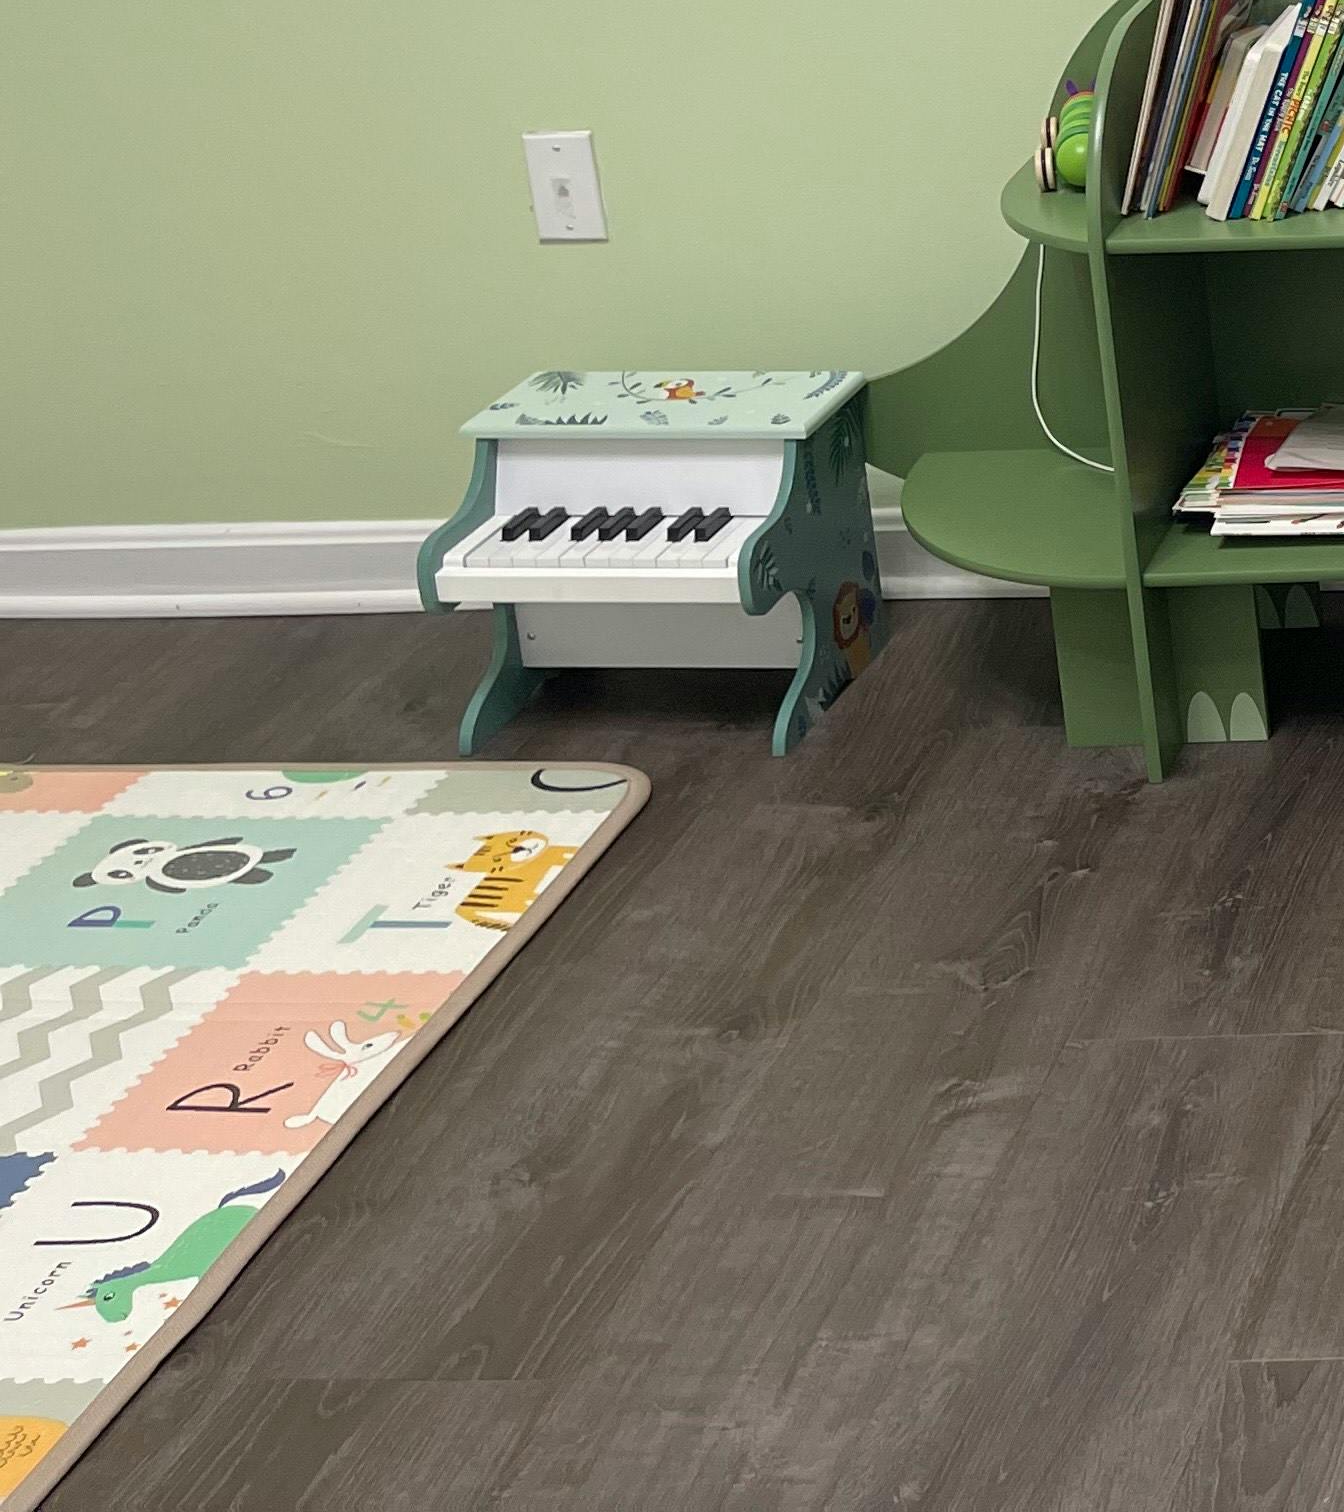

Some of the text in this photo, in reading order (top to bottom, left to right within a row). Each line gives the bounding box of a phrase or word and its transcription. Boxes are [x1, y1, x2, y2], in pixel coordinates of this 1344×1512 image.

[1278, 71, 1288, 87] THE
[1268, 107, 1276, 116] IN
[1272, 89, 1282, 105] CAT
[1263, 117, 1272, 131] THE
[1283, 98, 1301, 135] PICNIC
[1256, 134, 1267, 151] HAT
[411, 876, 455, 910] Tiger
[66, 905, 156, 928] P
[175, 903, 220, 934] Panda
[336, 904, 453, 944] T
[233, 1025, 291, 1072] Rabbit
[165, 1082, 294, 1114] R
[33, 1201, 160, 1246] U
[3, 1261, 73, 1322] Unicorn
